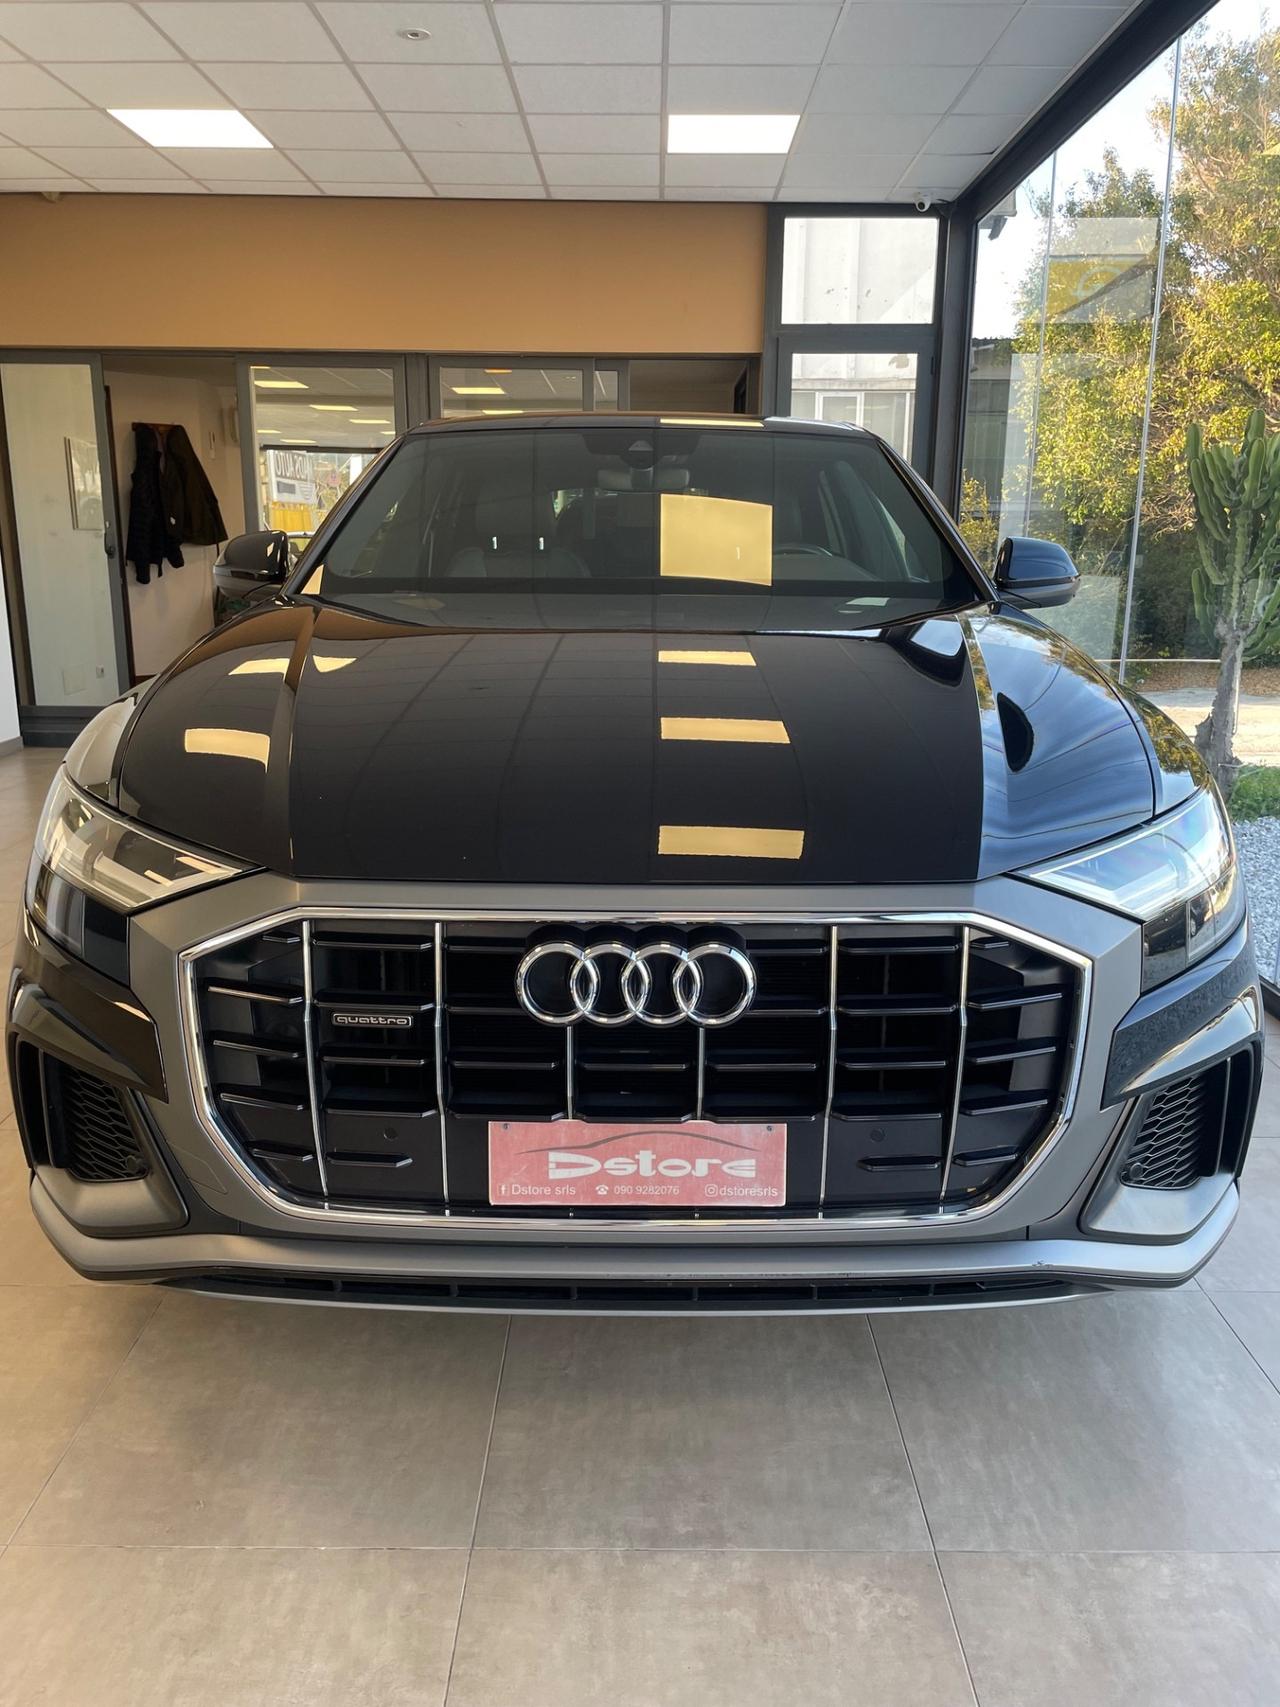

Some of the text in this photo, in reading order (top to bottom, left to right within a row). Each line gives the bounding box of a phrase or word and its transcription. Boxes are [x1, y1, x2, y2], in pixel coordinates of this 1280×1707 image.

[337, 1016, 407, 1024] quattro
[548, 1150, 756, 1180] Dstore
[511, 1184, 551, 1195] Dstore
[555, 1184, 576, 1195] srls
[614, 1185, 680, 1195] 090 9282076
[719, 1185, 778, 1197] dstoresrls
